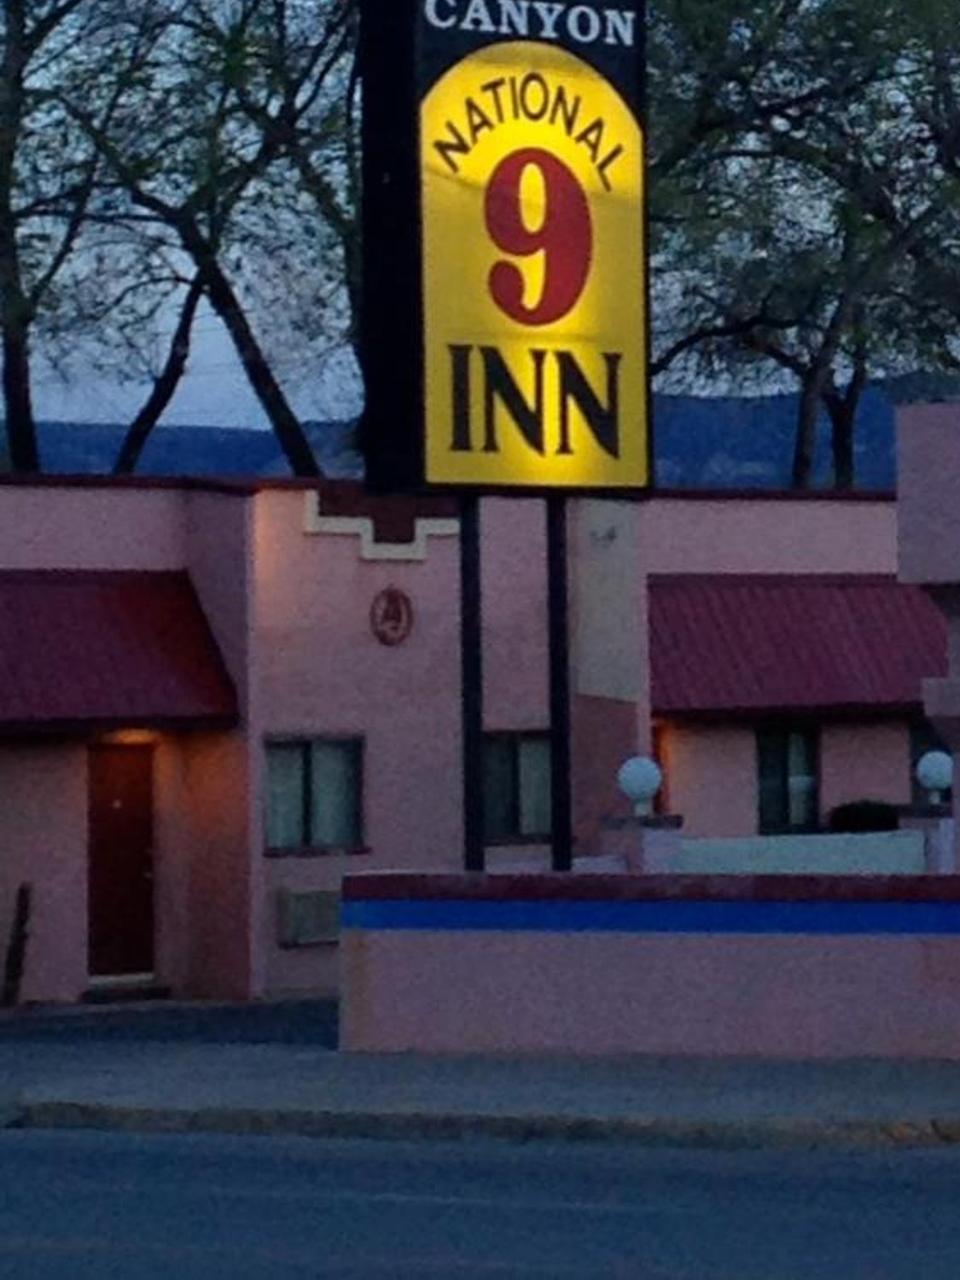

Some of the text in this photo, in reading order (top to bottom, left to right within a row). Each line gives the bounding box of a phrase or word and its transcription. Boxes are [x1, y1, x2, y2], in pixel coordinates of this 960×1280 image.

[432, 71, 625, 192] NATIONAL
[483, 146, 593, 328] 9
[448, 343, 624, 460] INN
